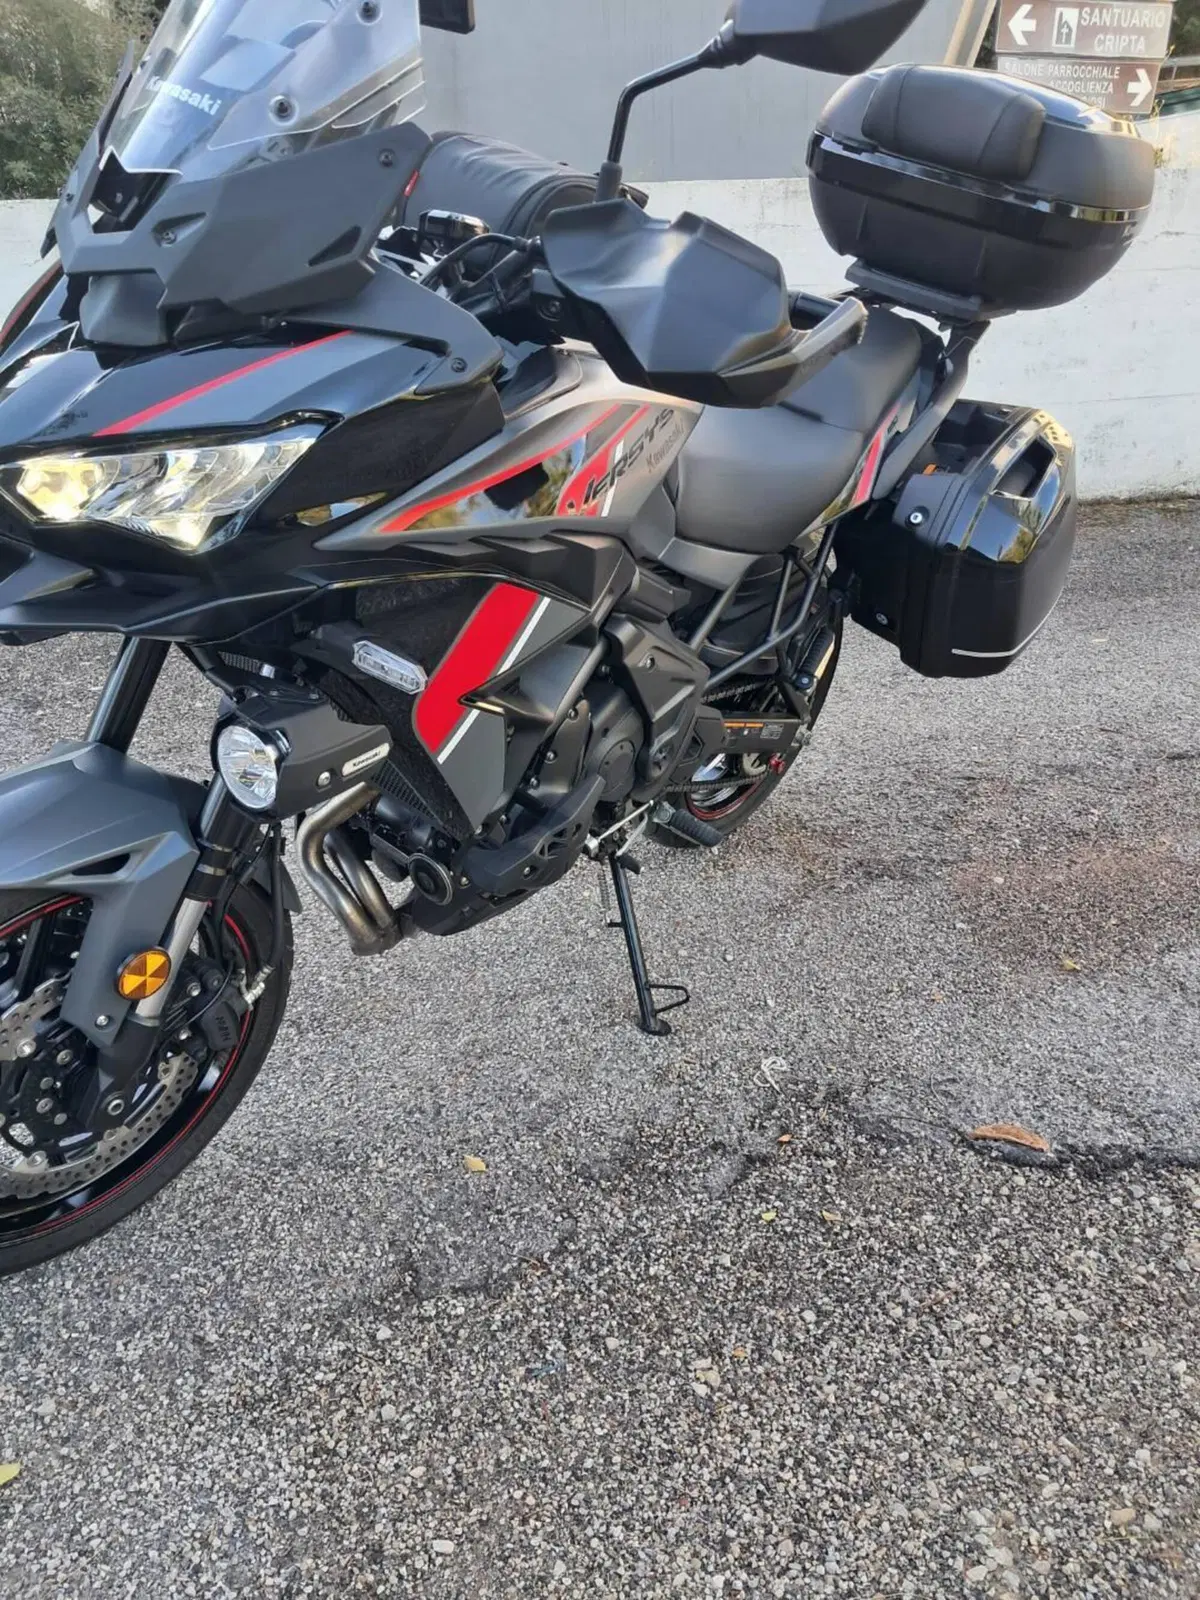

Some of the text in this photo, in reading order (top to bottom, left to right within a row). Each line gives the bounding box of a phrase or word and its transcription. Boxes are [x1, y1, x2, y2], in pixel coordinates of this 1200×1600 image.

[1080, 6, 1166, 28] SANTUARIO
[1093, 34, 1146, 53] CRIPTA
[1004, 62, 1120, 79] SALONE PARROCCHIALE
